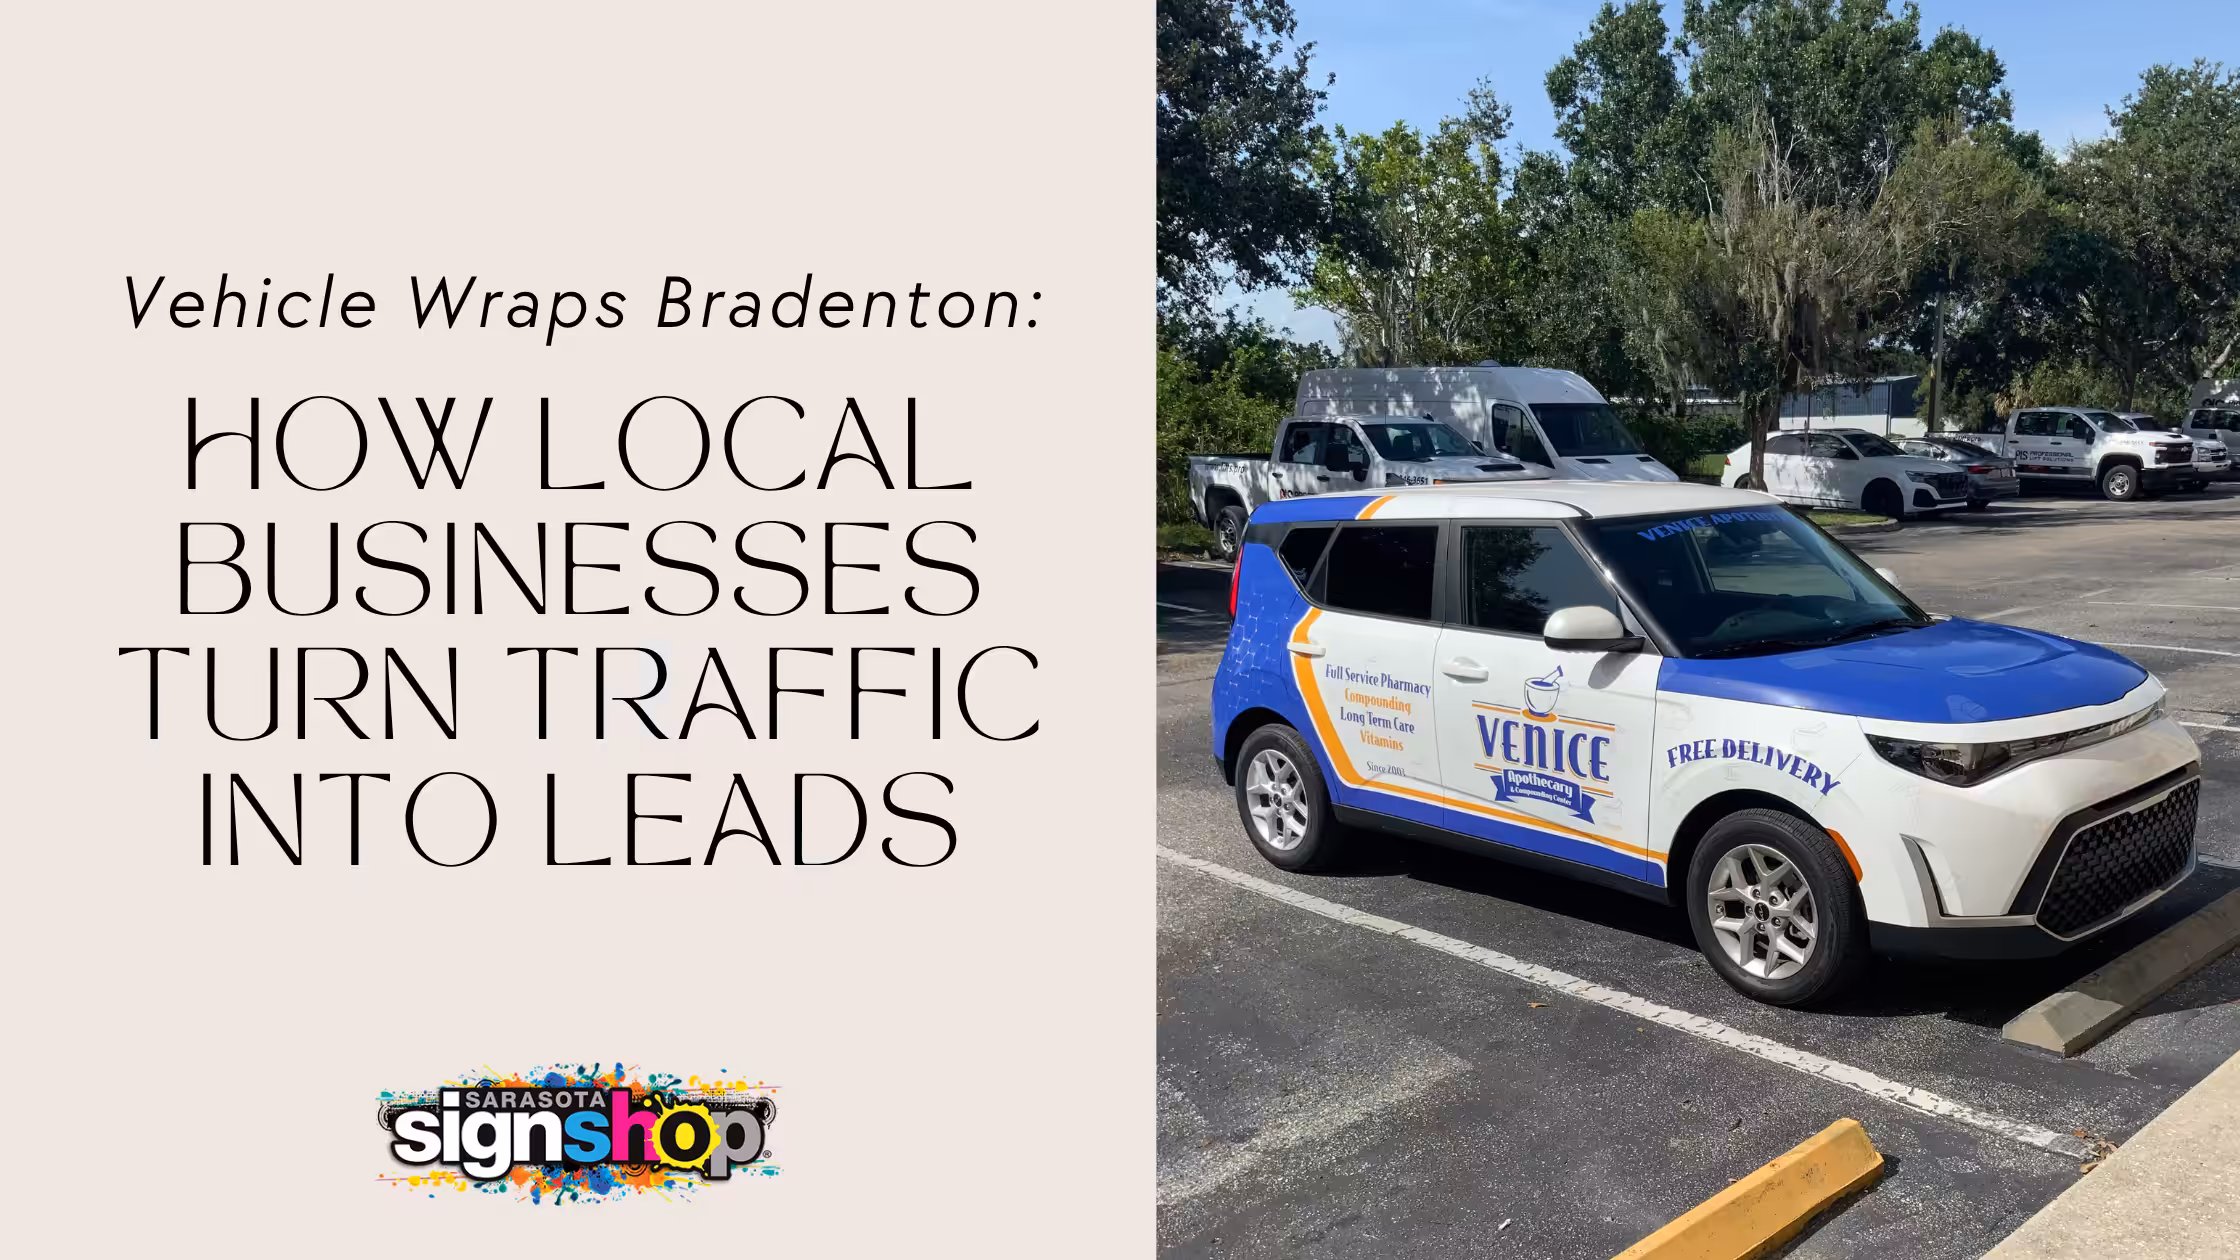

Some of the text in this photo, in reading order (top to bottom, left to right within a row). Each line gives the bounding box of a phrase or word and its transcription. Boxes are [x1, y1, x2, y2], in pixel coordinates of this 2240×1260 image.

[1637, 516, 1711, 541] VENICE
[1325, 664, 1431, 698] Full Service Pharmacy
[1345, 687, 1411, 716] Compounding
[1340, 706, 1415, 734] Long Term Care
[1360, 730, 1404, 751] Vitamins
[1475, 714, 1610, 784] VENICE
[1366, 760, 1386, 773] Since
[1667, 738, 1841, 797] FREE DELIVERY
[1508, 770, 1573, 797] Apothecary
[1515, 787, 1553, 800] Compounding
[1553, 795, 1572, 805] Center
